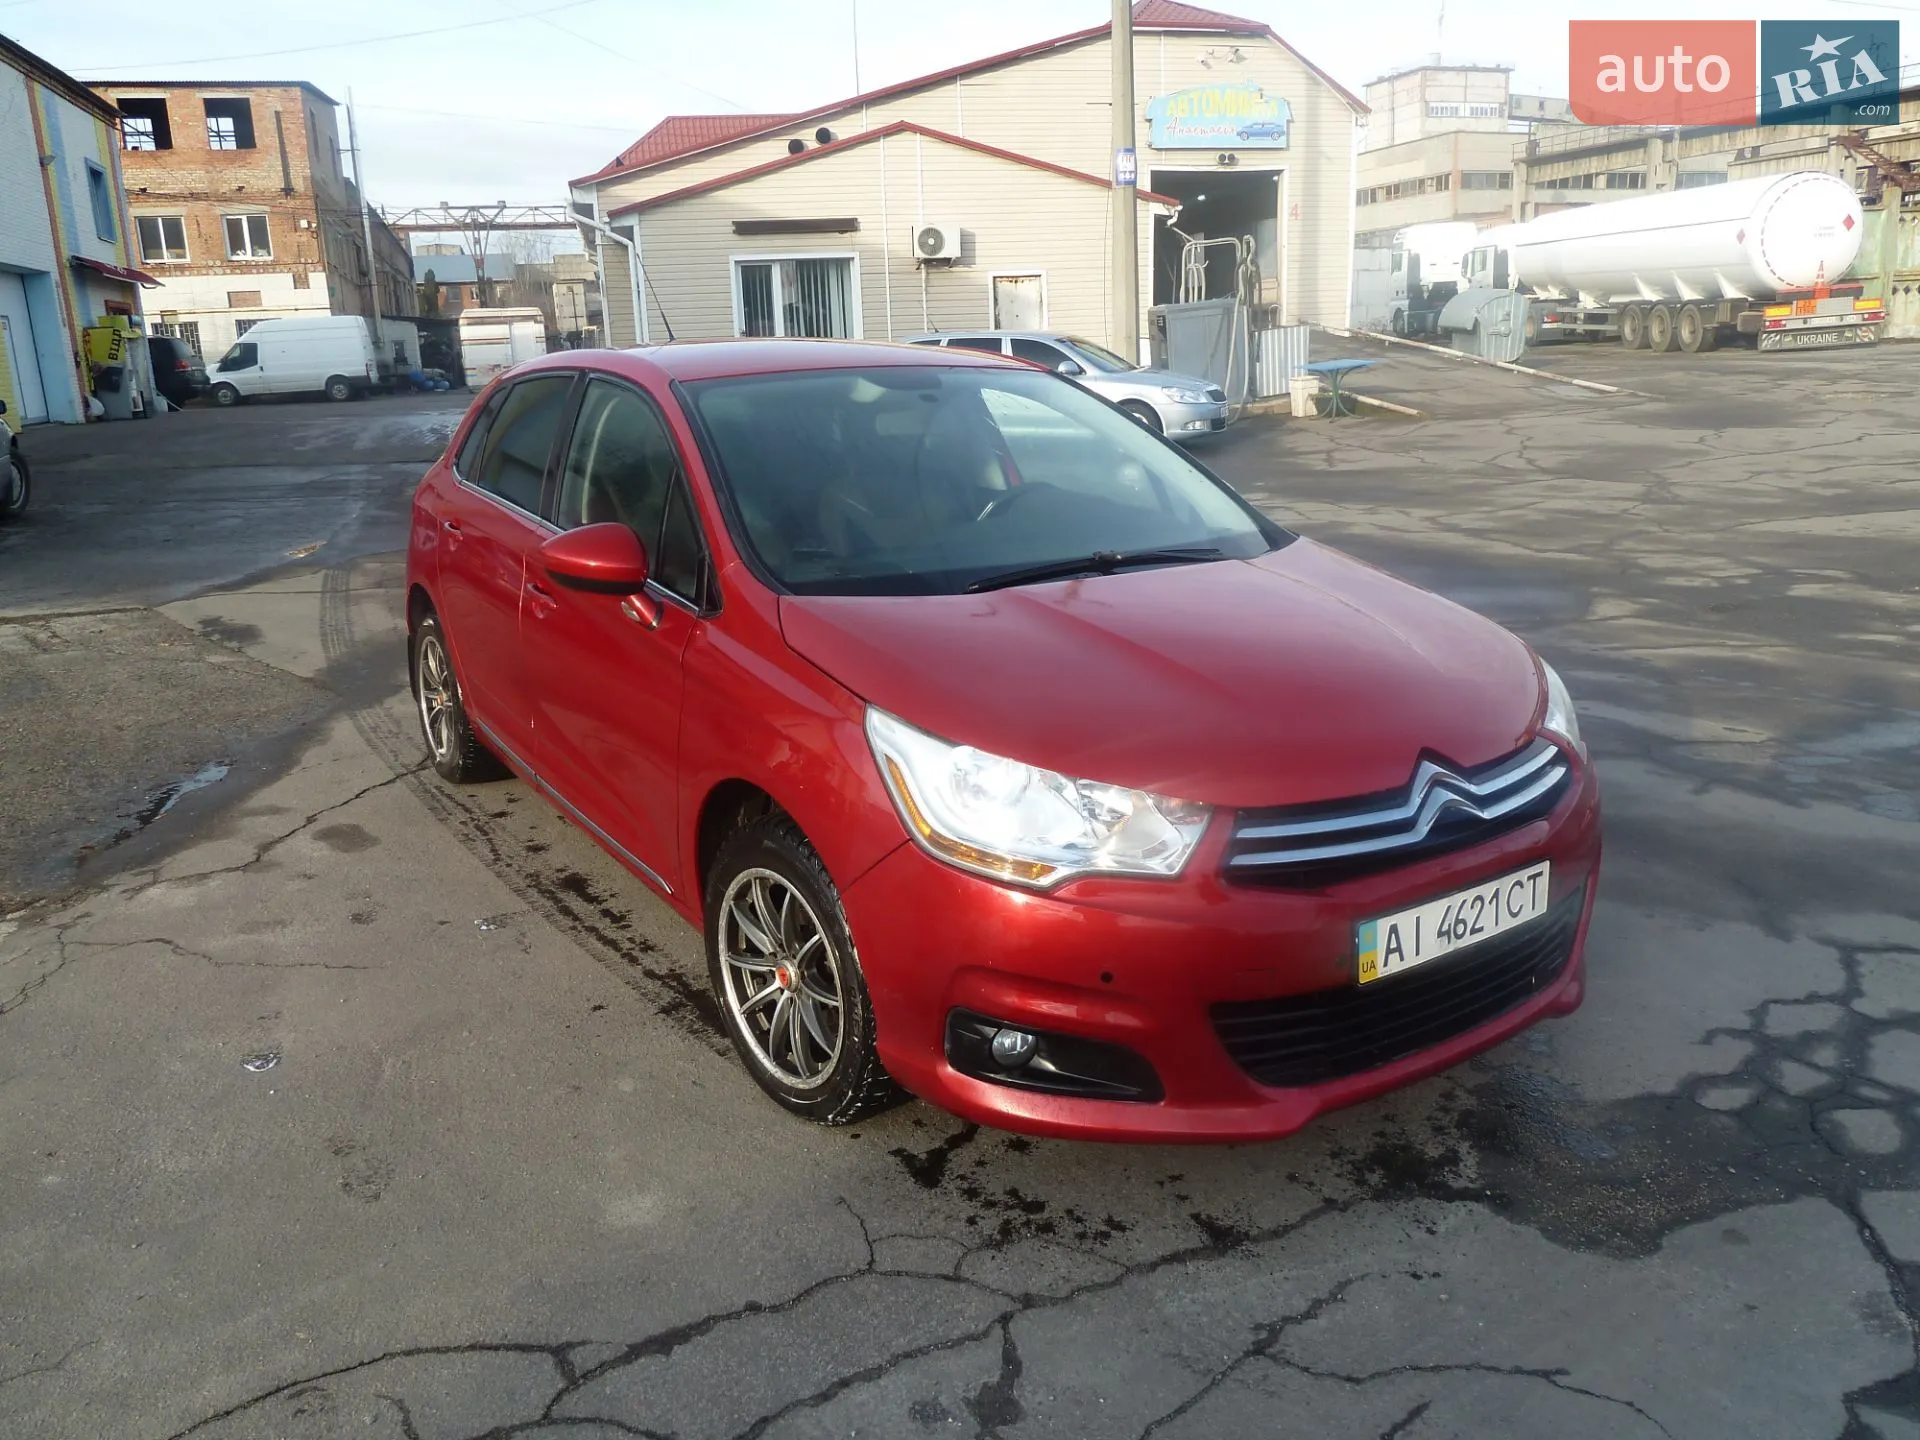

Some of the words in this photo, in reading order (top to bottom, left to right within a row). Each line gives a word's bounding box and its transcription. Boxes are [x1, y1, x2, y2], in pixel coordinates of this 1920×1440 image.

[1166, 87, 1279, 117] АВТОМИА
[1797, 333, 1838, 345] UKRAINE
[1361, 960, 1377, 974] UA
